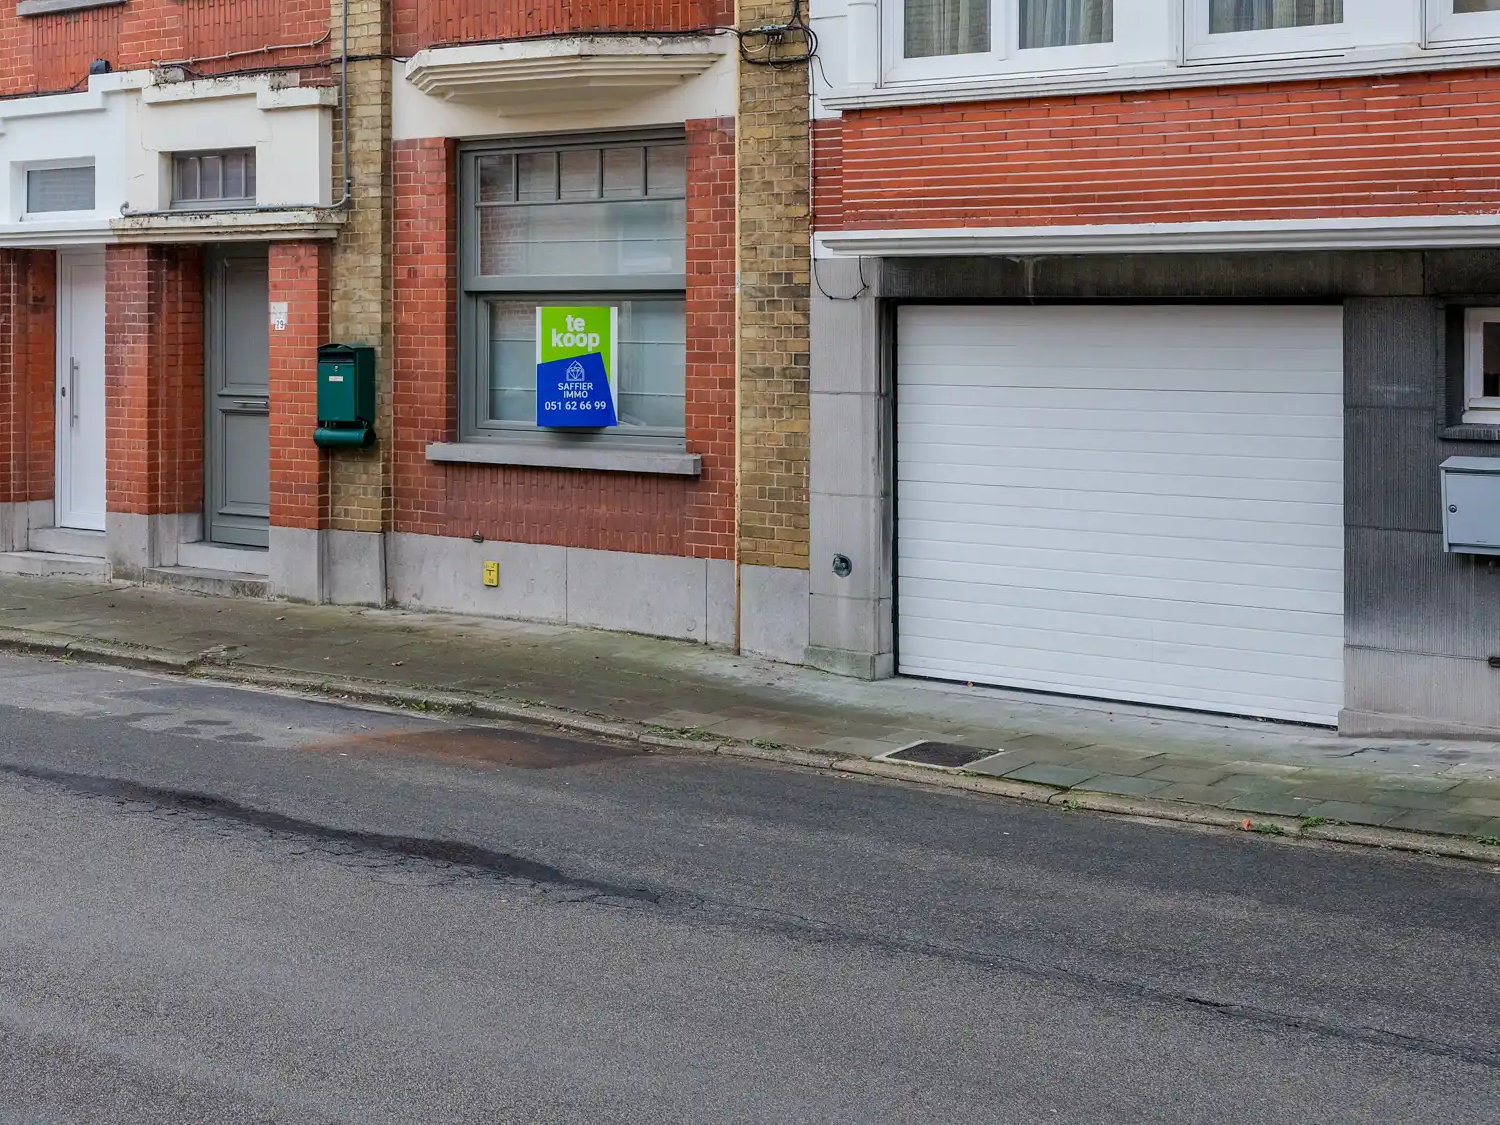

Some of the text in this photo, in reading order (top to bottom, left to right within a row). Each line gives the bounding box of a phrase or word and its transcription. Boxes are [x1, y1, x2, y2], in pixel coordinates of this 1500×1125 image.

[276, 319, 284, 329] 29
[565, 315, 585, 332] te
[551, 328, 600, 351] koop
[557, 382, 593, 390] SAFFIER
[544, 401, 606, 410] 051 62 66 99
